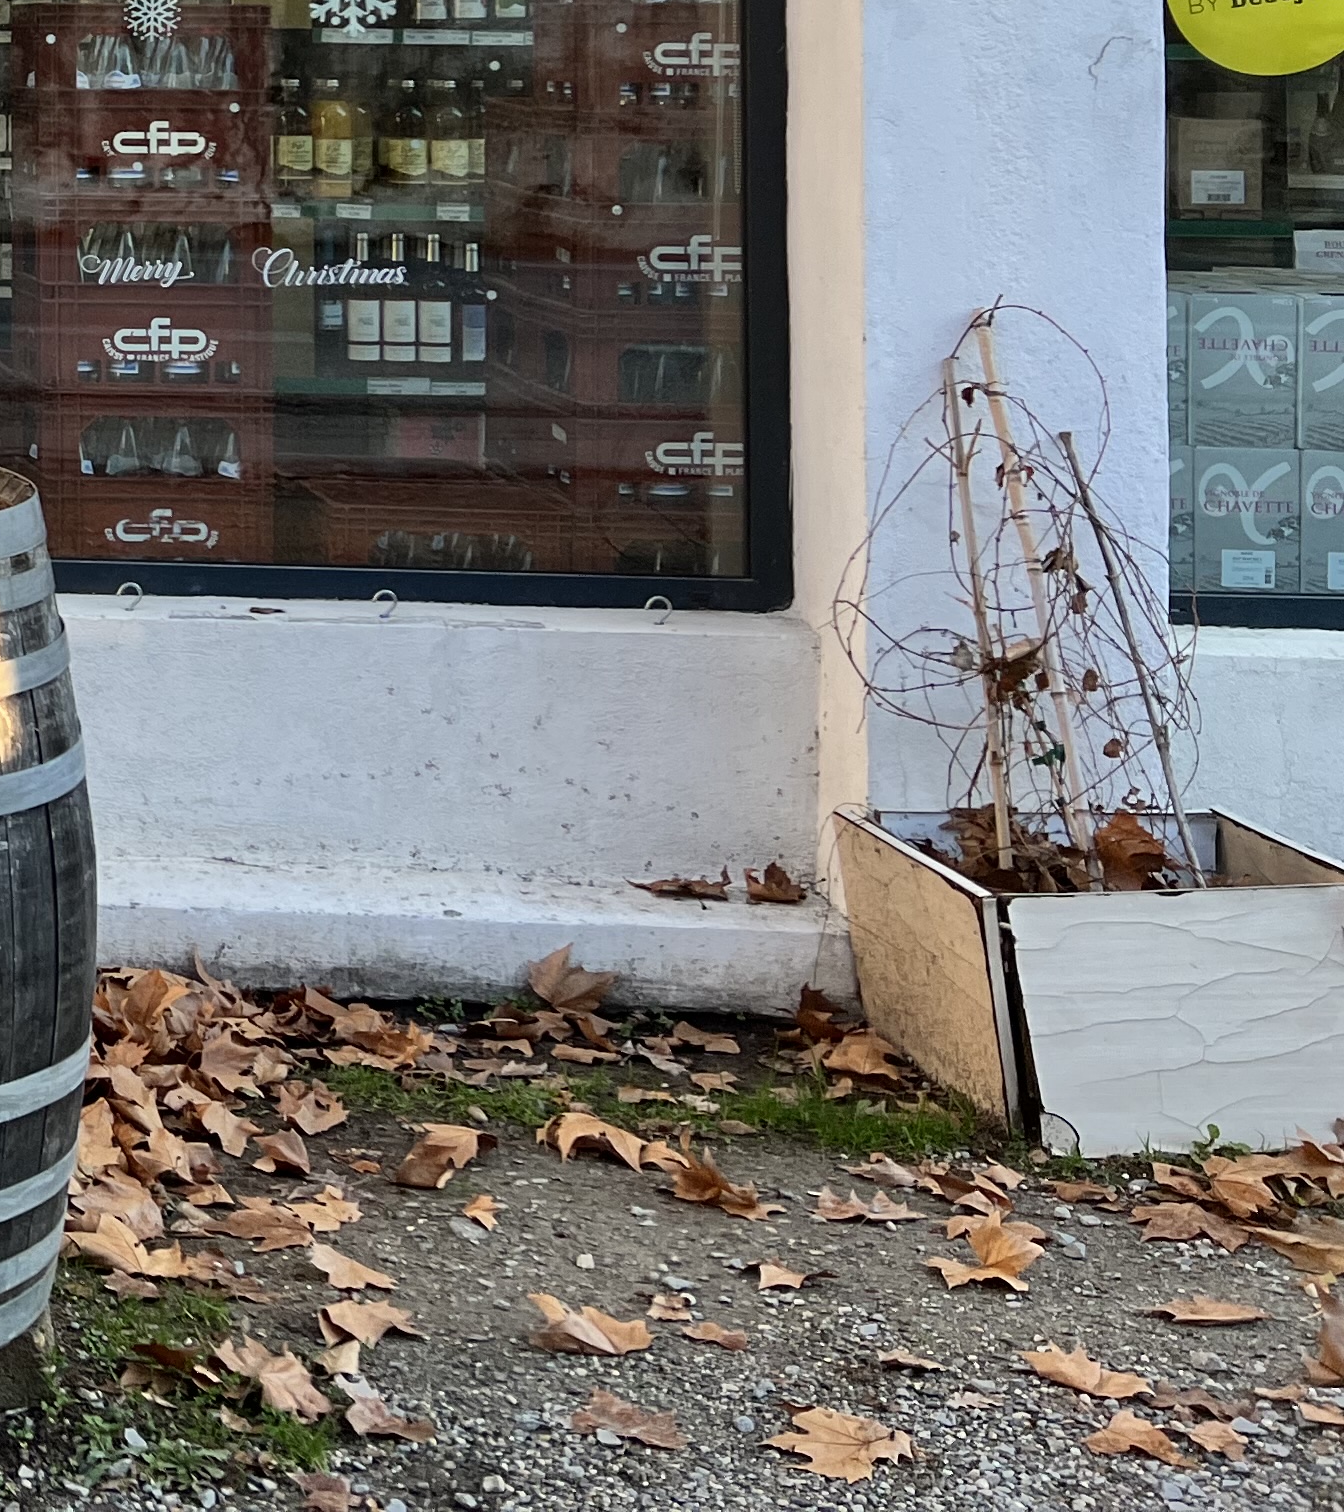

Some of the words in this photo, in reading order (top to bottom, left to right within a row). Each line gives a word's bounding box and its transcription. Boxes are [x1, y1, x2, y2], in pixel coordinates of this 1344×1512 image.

[676, 67, 710, 76] FRANCE
[79, 254, 195, 289] Merry
[251, 246, 410, 289] Christmas
[674, 273, 711, 282] FRANCE
[113, 317, 207, 359] cfp
[1199, 338, 1288, 351] CHAVETTE
[1203, 500, 1294, 514] CHAVETTE
